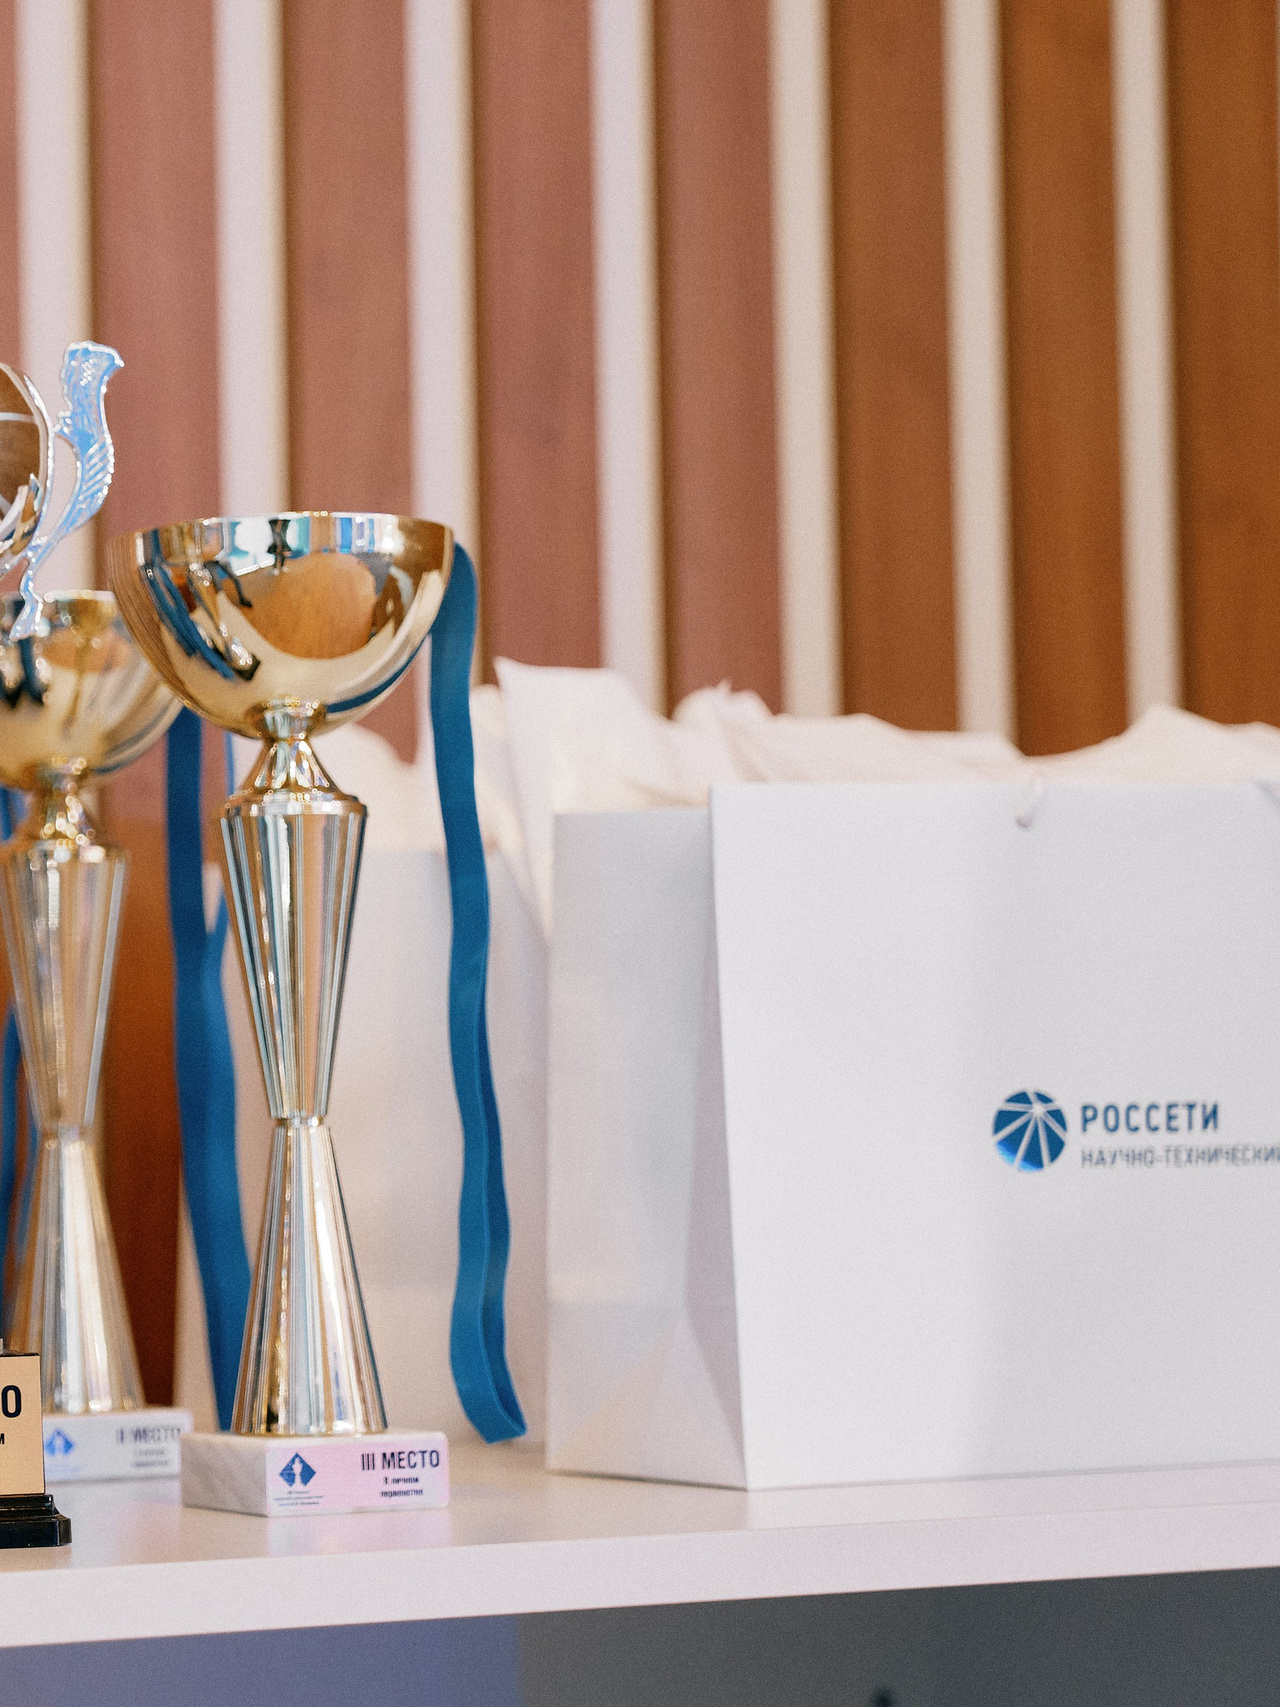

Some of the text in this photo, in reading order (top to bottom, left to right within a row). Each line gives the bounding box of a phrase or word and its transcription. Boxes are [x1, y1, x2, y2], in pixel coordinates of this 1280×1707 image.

[1080, 1100, 1220, 1134] РОССЕТИ
[1080, 1144, 1280, 1169] НАУЧНО-ТЕХНИЧЕСКИ
[381, 1449, 440, 1470] МЕСТО
